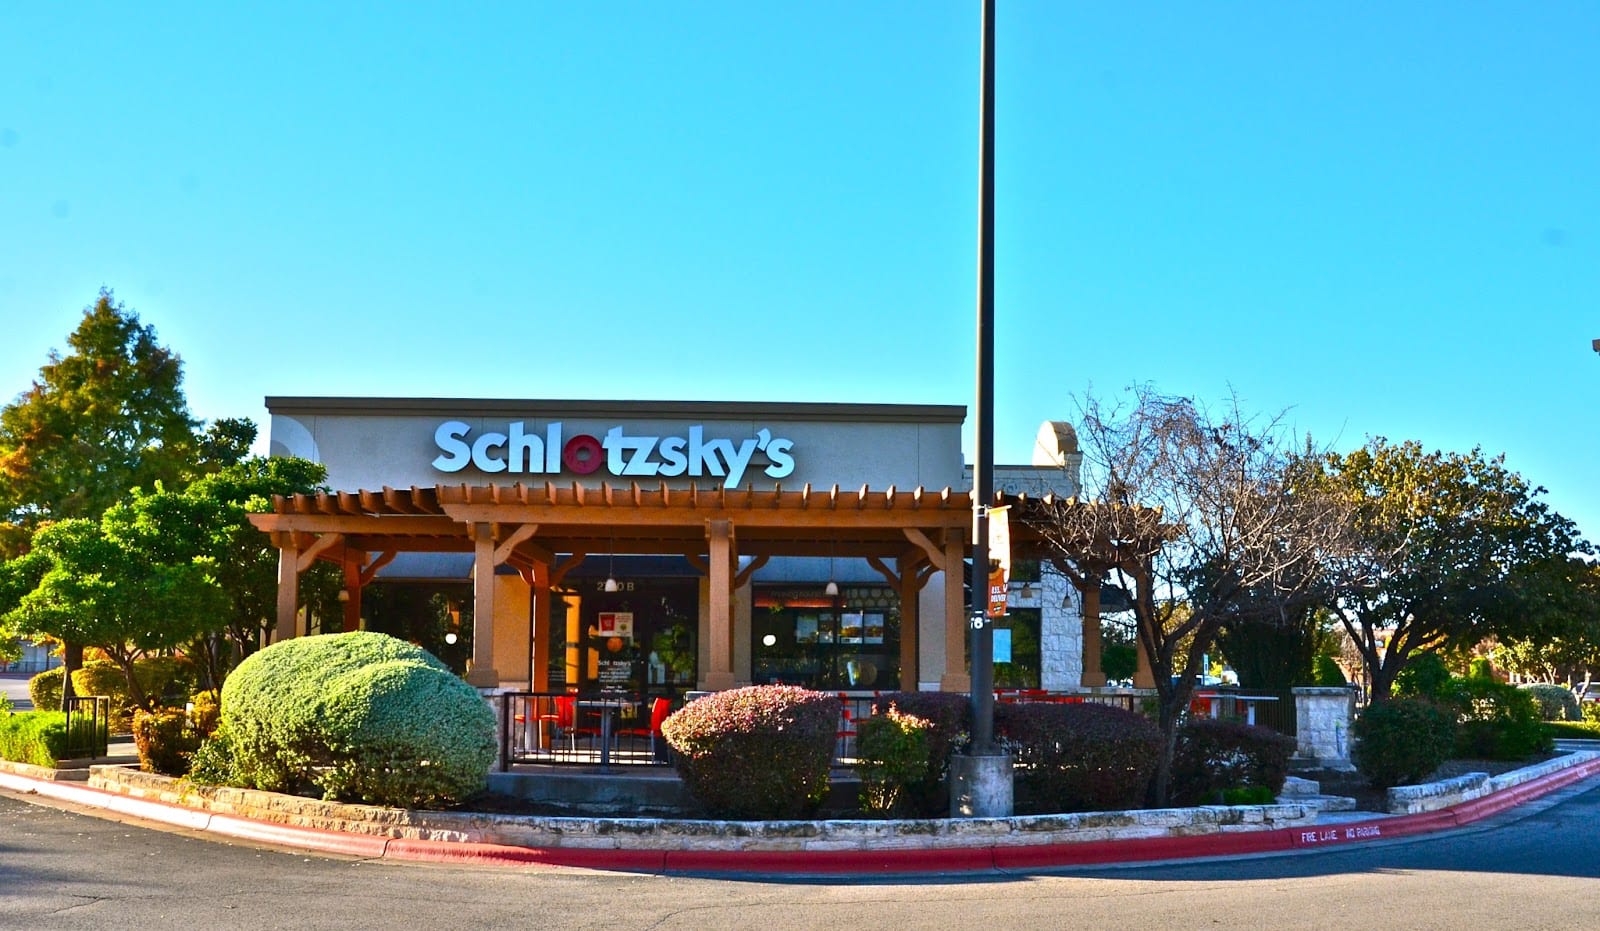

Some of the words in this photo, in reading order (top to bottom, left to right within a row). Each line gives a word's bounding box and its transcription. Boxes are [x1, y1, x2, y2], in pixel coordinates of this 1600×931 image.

[431, 420, 795, 489] Schlotzsky's
[1301, 831, 1318, 843] FIRE
[1320, 829, 1338, 841] LANE
[1345, 828, 1355, 839] NO
[1356, 826, 1381, 837] PARKING
